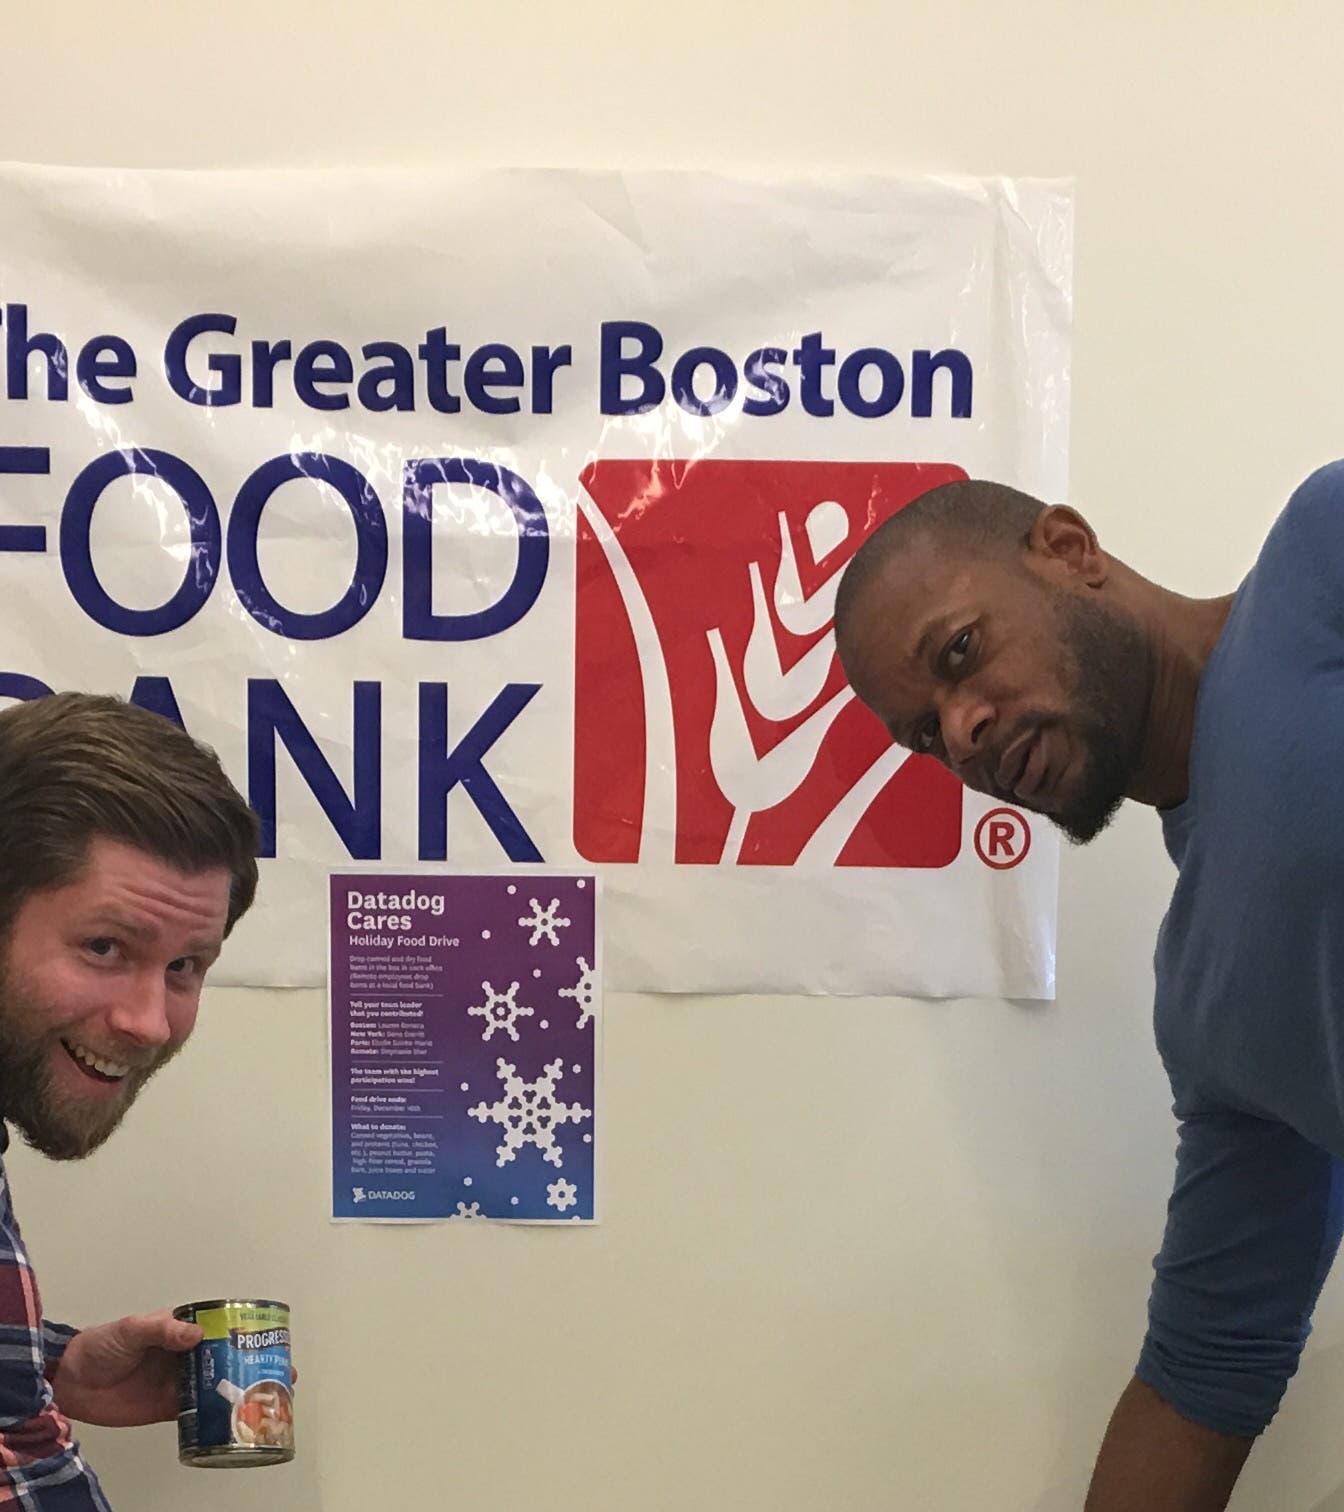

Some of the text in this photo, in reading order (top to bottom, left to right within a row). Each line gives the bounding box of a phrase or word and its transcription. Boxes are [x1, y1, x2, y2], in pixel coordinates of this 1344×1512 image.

[164, 312, 572, 415] Greater
[599, 321, 972, 419] Boston
[347, 889, 445, 916] Datadog
[347, 911, 412, 930] Cares
[349, 934, 460, 949] Holiday Food Drive
[368, 1191, 415, 1200] DATADOG
